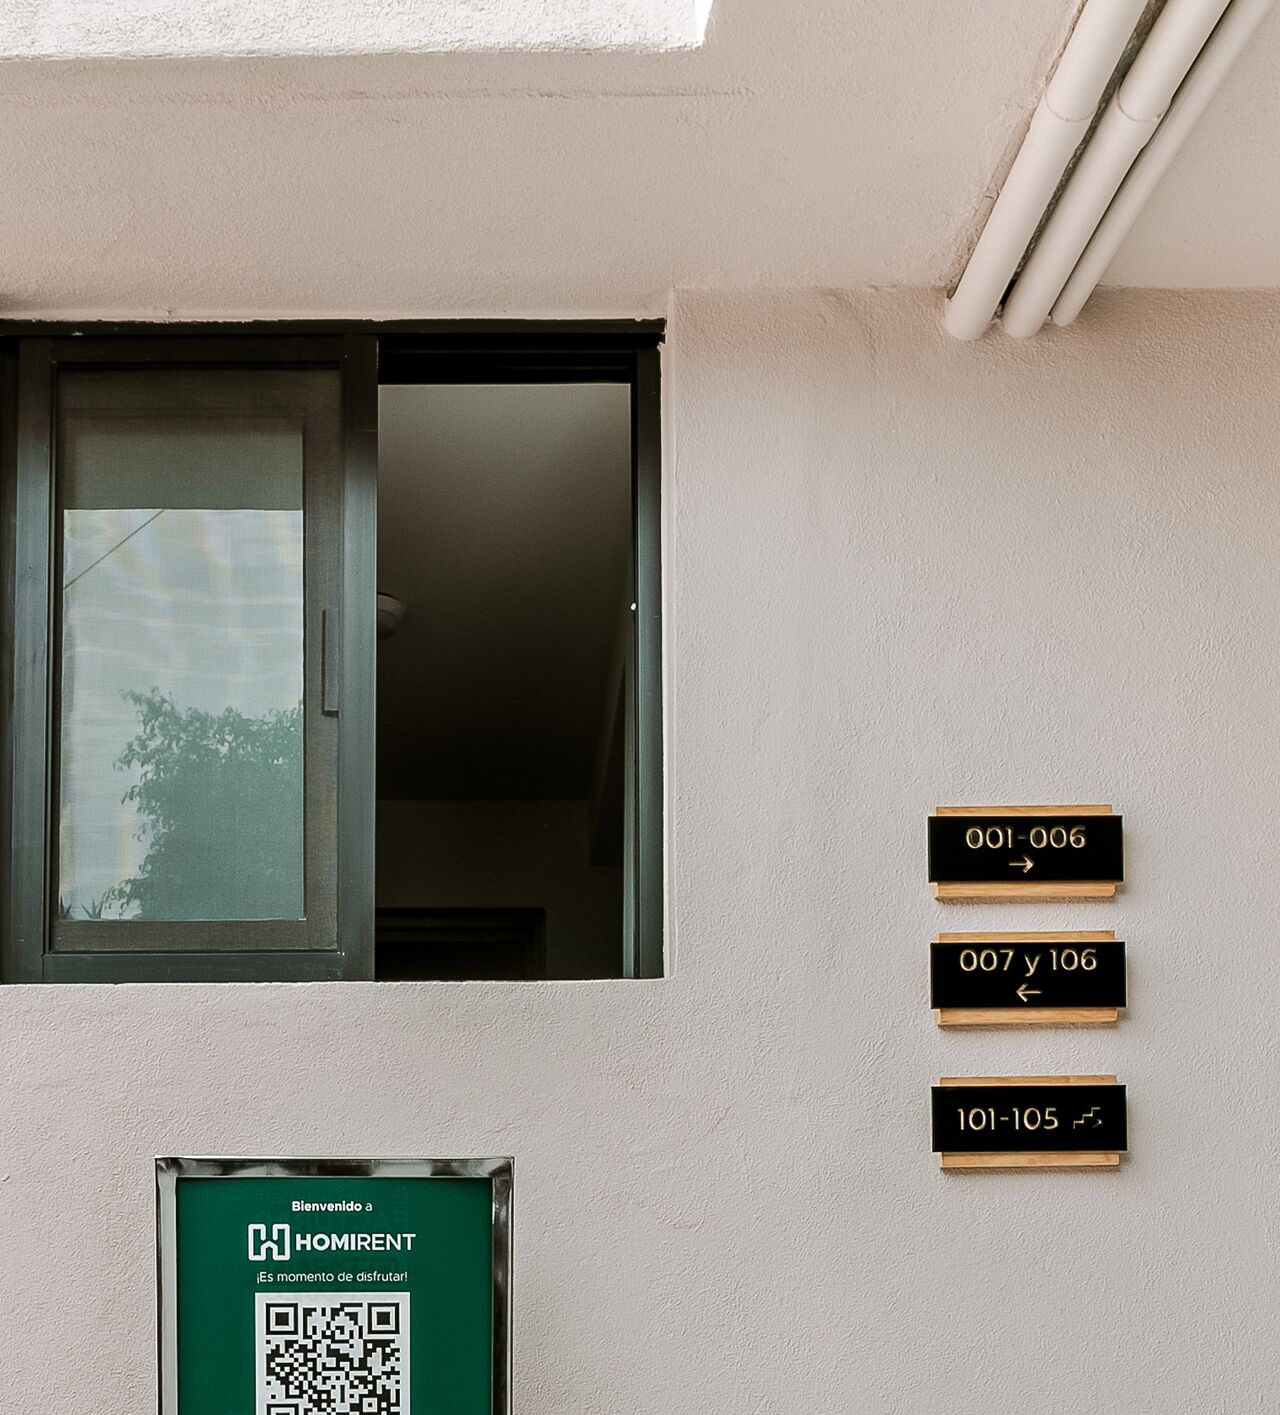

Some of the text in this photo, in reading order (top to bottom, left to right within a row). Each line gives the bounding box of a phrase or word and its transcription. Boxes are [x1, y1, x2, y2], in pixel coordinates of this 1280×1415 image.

[965, 825, 1087, 849] 001-006
[959, 949, 1098, 977] 007 y 106
[957, 1107, 1059, 1131] 101-105
[292, 1200, 372, 1212] Bienvenido a
[295, 1233, 416, 1251] HOMIRENT
[256, 1271, 408, 1284] ¡Es momento de disfrutar!
